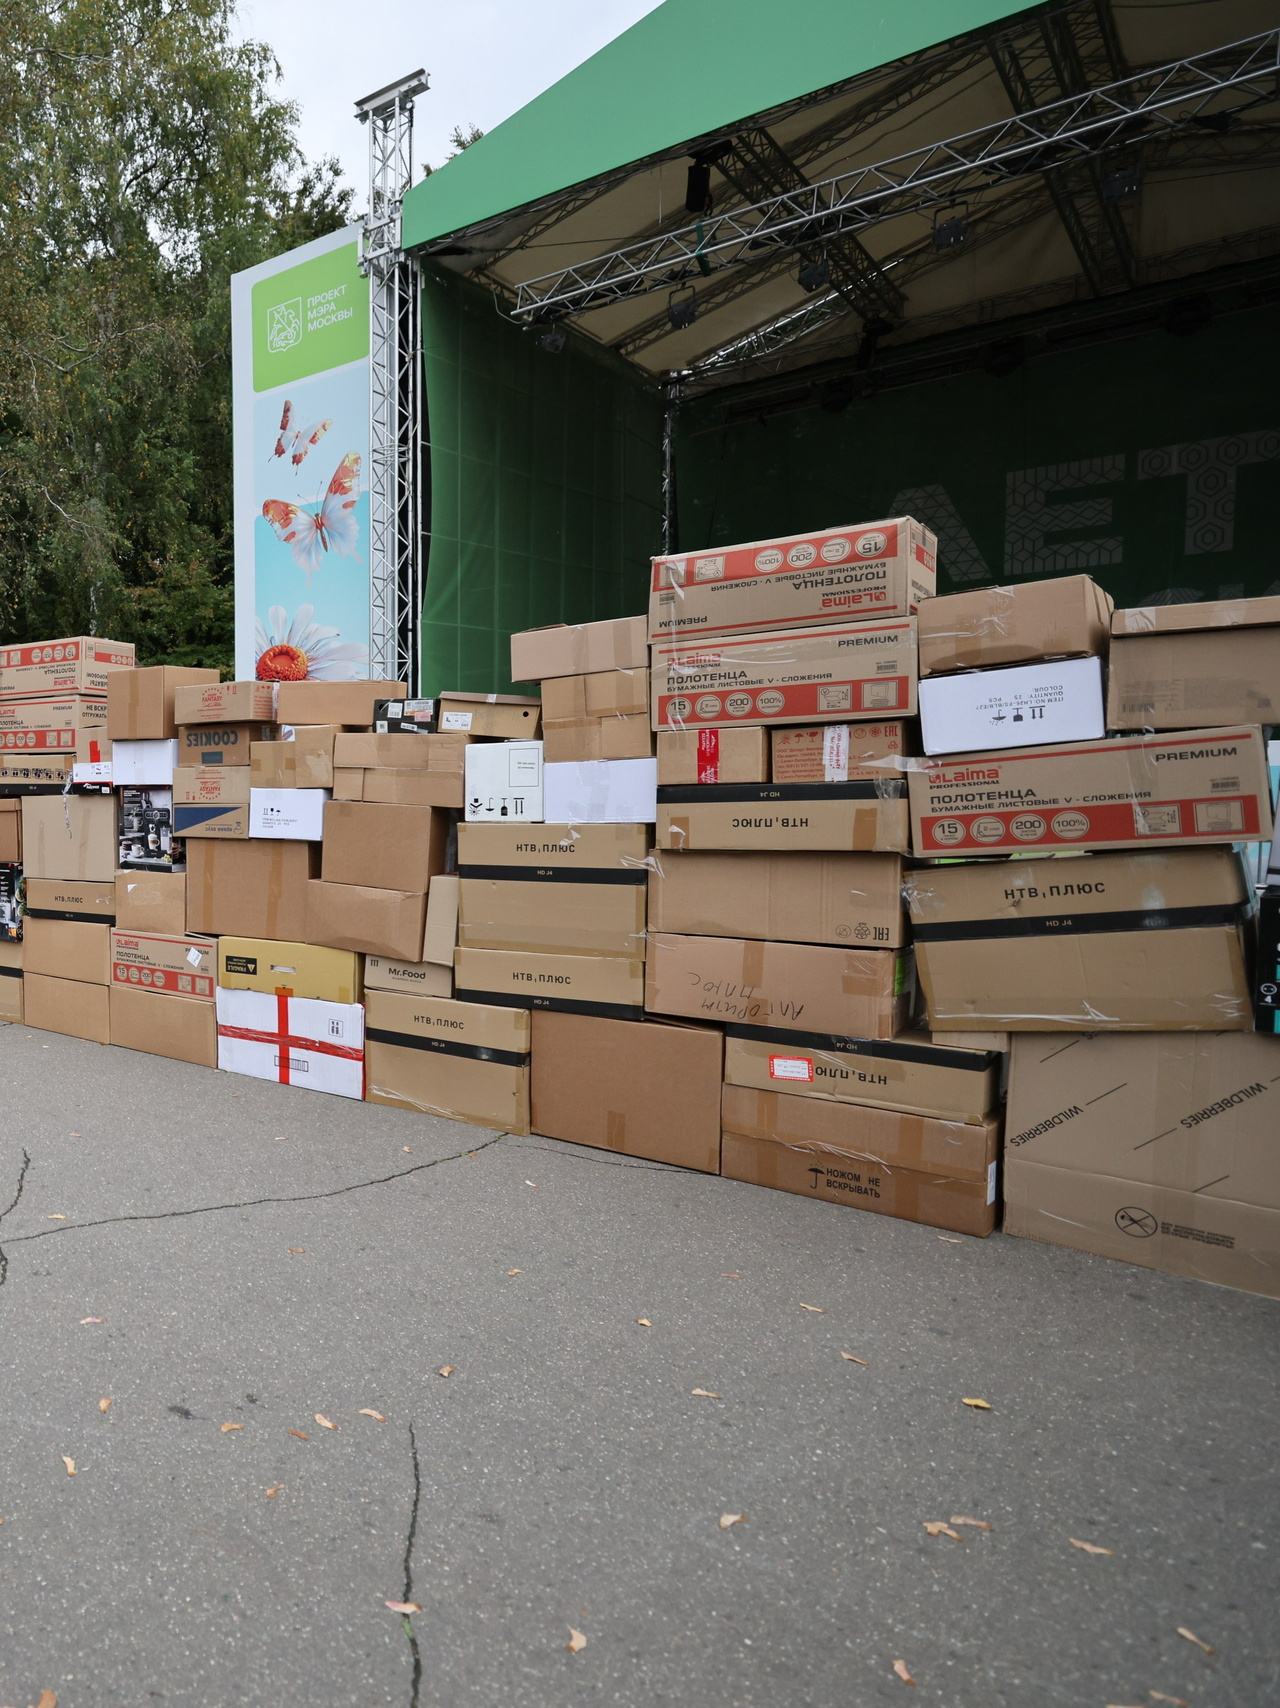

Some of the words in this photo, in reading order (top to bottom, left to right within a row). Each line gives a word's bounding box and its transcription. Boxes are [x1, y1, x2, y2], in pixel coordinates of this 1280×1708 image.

[307, 284, 347, 308] ПРОЕКТ
[307, 302, 336, 320] МЭРА
[307, 307, 353, 332] МОСКВЫ
[862, 541, 882, 555] 15
[790, 550, 813, 562] 200
[775, 569, 826, 583] ЛИСТОВЫЕ
[828, 562, 886, 576] БУМАЖНЫЕ
[710, 579, 757, 592] СЛОЖЕНИЯ
[792, 571, 887, 590] ПОЛОТЕНЦА
[822, 585, 886, 598] PROFESSIONAL
[659, 616, 708, 629] PREMIUM
[838, 634, 899, 648] PREMIUM
[667, 670, 748, 685] ПОЛОТЕНЦА
[667, 682, 715, 693] БУМАЖНЫЕ
[717, 678, 764, 689] ЛИСТОВЫЕ
[781, 673, 833, 683] СЛОЖЕНИЯ
[670, 700, 686, 711] 15
[729, 697, 749, 707] 200
[759, 697, 782, 705] 100%
[186, 730, 239, 748] COOKIES
[940, 767, 1000, 783] Laima
[1155, 747, 1239, 762] PREMIUM
[929, 779, 1000, 790] PROFESSIONAL
[930, 788, 1037, 806] ПОЛОТЕНЦА
[931, 803, 996, 814] БУМАЖНЫЕ
[998, 798, 1060, 810] ЛИСТОВЫЕ
[1083, 791, 1152, 803] СЛОЖЕНИЯ
[937, 822, 958, 835] 15
[1015, 819, 1042, 830] 200
[1055, 819, 1086, 828] 100%
[1046, 919, 1059, 927] HD
[1061, 919, 1072, 927] J4
[116, 951, 150, 961] ПОЛОТЕНЦА
[388, 967, 426, 979] Mr.Food
[1180, 1082, 1268, 1129] WILDBERRIES
[1010, 1105, 1084, 1147] WILDBERRIES
[826, 1168, 861, 1183] НОЖОМ
[868, 1177, 881, 1187] НЕ
[826, 1180, 881, 1199] ВСКРЫВАТЬ
